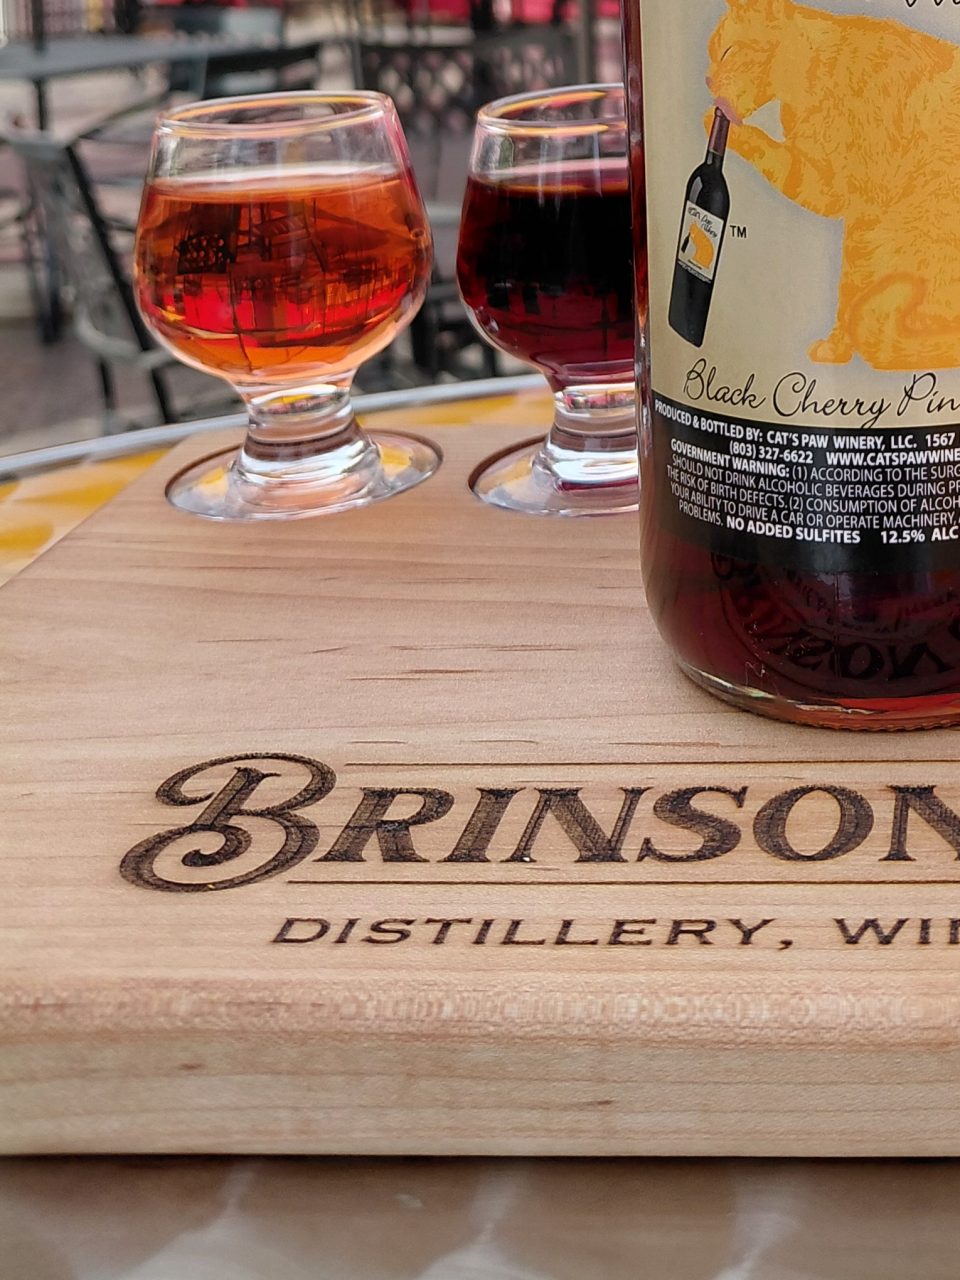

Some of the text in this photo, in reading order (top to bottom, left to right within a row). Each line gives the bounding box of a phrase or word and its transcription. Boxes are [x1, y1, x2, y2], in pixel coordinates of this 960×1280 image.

[683, 357, 766, 409] Black
[773, 372, 891, 429] Cherry
[655, 399, 692, 426] PRODUCED
[692, 415, 700, 429] &
[701, 417, 744, 439] BOTTLED
[746, 427, 763, 442] BY:
[767, 431, 799, 446] CAT'S
[802, 434, 829, 449] PAW
[833, 435, 886, 451] WINERY,
[891, 435, 917, 449] LLC.
[926, 432, 956, 447] 1567
[670, 438, 731, 467] GOVERNMENT
[732, 456, 790, 478] WARNING:
[792, 465, 808, 480] (1)
[810, 467, 883, 482] ACCORDING
[885, 468, 902, 481] TO
[904, 467, 928, 480] THE
[729, 440, 757, 459] (803)
[758, 446, 814, 464] 327-6622
[667, 465, 679, 478] THE
[680, 471, 696, 488] RISK
[697, 478, 709, 491] OF
[711, 482, 737, 501] BIRTH
[739, 488, 788, 509] DEFECTS.
[789, 496, 803, 512] (2)
[806, 498, 897, 514] CONSUMPTION
[900, 499, 917, 512] OF
[672, 453, 703, 476] SHOULD
[704, 462, 724, 480] NOT
[725, 470, 756, 489] DRINK
[758, 477, 822, 496] ALCOHOLIC
[825, 484, 894, 498] BEVERAGES
[898, 481, 946, 496] DURING
[670, 481, 690, 500] YOUR
[690, 491, 722, 511] ABILITY
[723, 499, 736, 514] TO
[738, 503, 769, 521] DRIVE
[770, 509, 779, 522] A
[780, 511, 804, 525] CAR
[806, 513, 824, 527] OR
[826, 514, 880, 529] OPERATE
[883, 511, 956, 529] MACHINERY,
[679, 499, 724, 526] PROBLEMS.
[726, 515, 745, 531] NO
[746, 519, 793, 539] ADDED
[795, 526, 861, 544] SULFITES
[880, 529, 926, 544] 12.5%
[931, 526, 959, 541] ALC
[272, 917, 794, 951] DISTILLERY,
